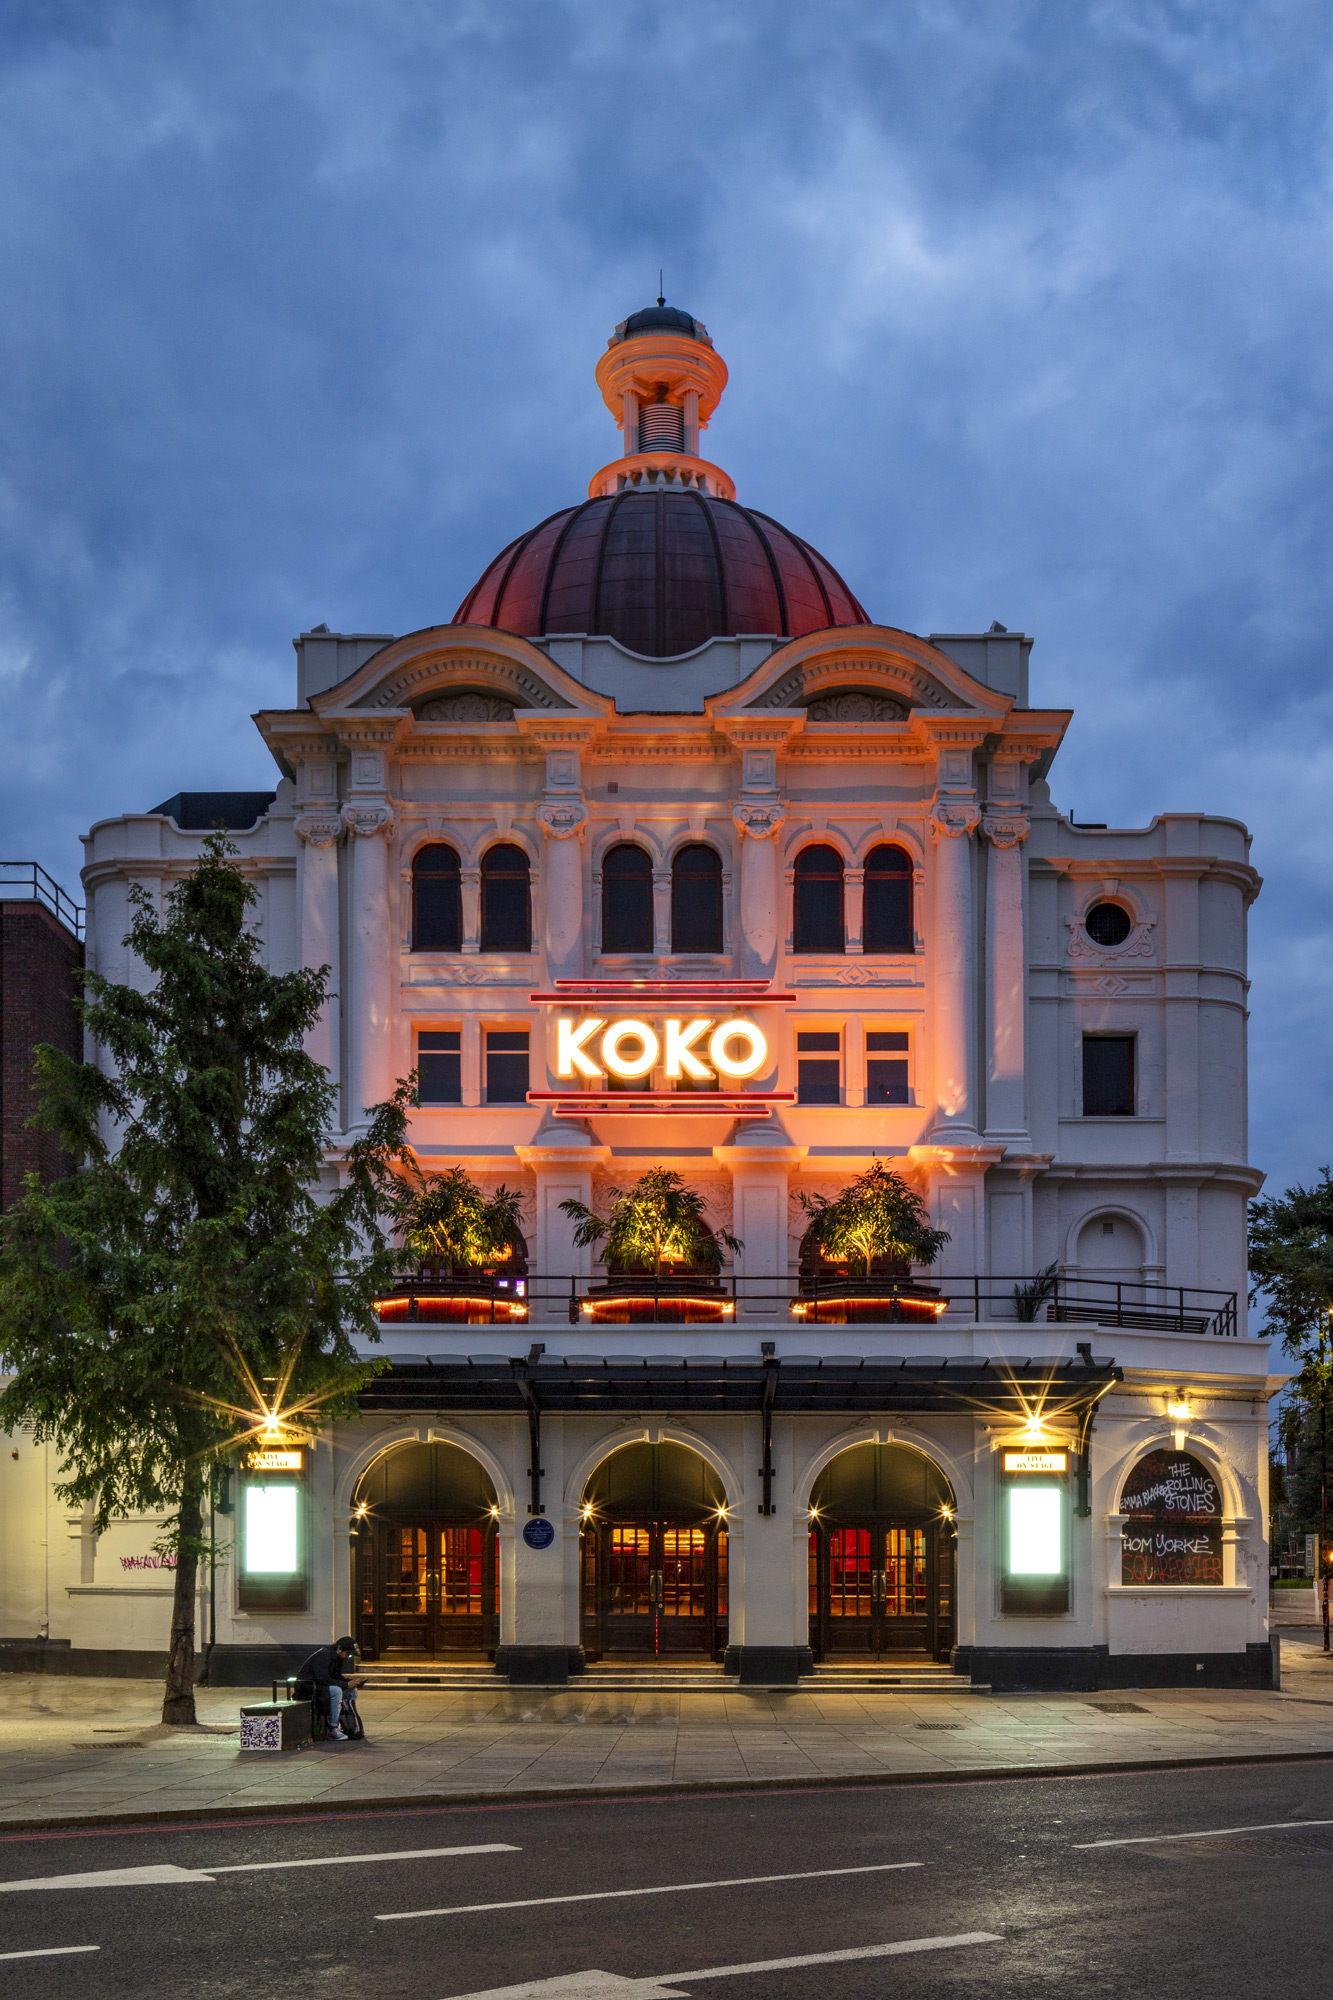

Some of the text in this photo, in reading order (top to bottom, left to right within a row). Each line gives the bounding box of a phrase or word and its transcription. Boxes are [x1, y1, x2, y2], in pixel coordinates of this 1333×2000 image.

[557, 1018, 768, 1080] KOKO
[1168, 1463, 1191, 1477] THE
[1165, 1477, 1216, 1494] ROLLING
[1119, 1494, 1143, 1510] EMMA
[1164, 1493, 1216, 1513] STONES
[1122, 1533, 1214, 1557] HOM YORKE
